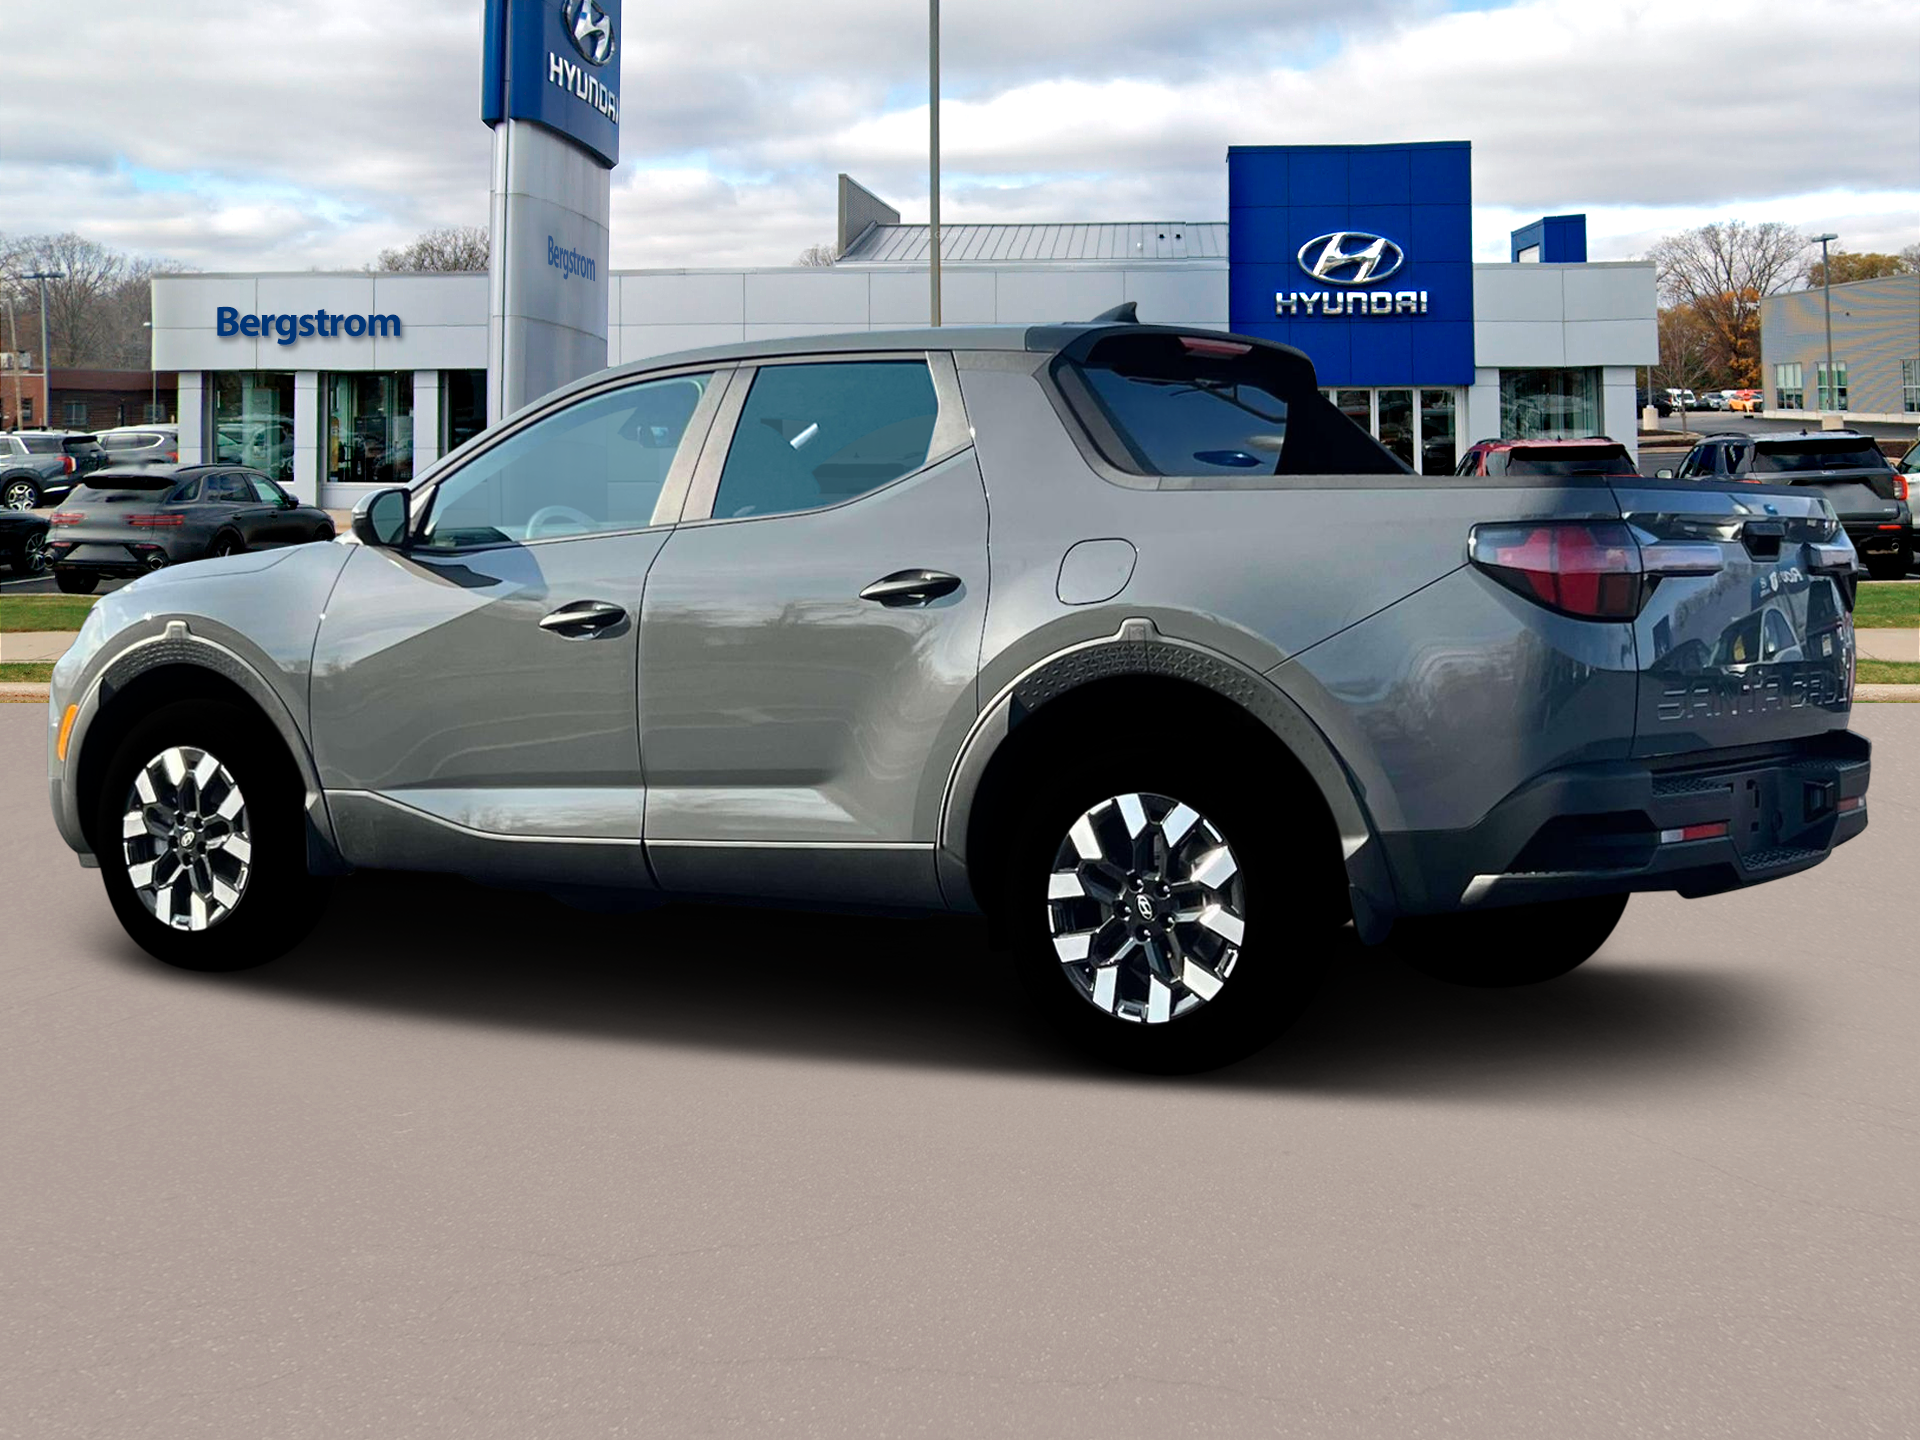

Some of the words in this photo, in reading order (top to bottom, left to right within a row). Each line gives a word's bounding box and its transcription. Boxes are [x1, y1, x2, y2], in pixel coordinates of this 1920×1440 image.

[548, 52, 620, 125] HYUNDAI
[547, 235, 596, 282] Bergstrom
[216, 306, 402, 346] Bergstrom
[1275, 290, 1429, 316] HYUNDAI
[1657, 674, 1783, 721] SANTA
